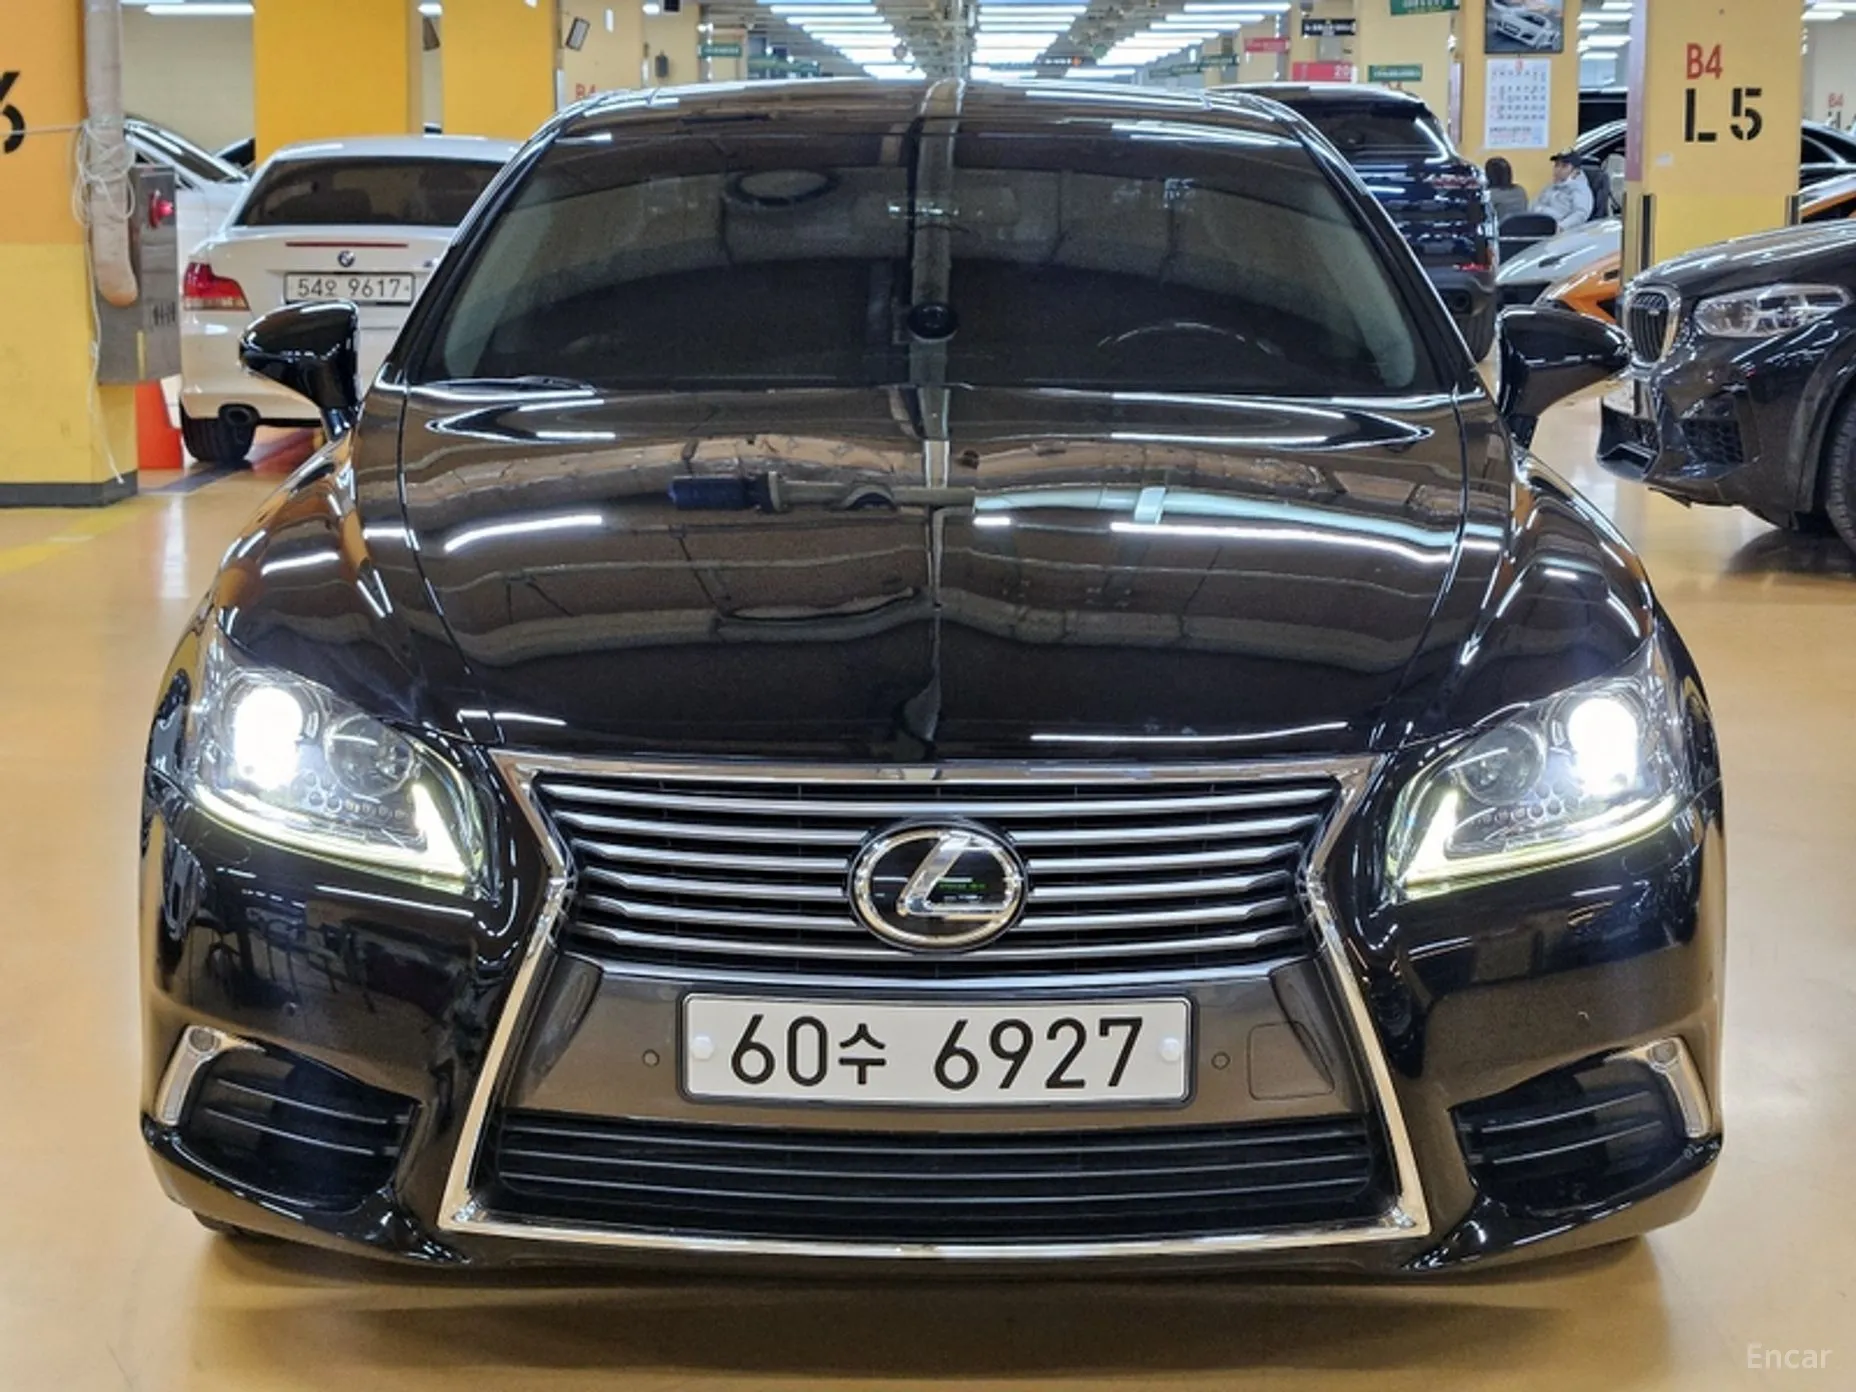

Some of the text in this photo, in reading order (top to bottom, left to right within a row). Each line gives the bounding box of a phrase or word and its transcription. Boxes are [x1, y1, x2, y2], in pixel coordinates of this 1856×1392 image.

[1685, 42, 1723, 80] B4
[1685, 87, 1763, 143] L 5
[298, 277, 401, 298] 54오 9617
[730, 1014, 1144, 1091] 60수 6927
